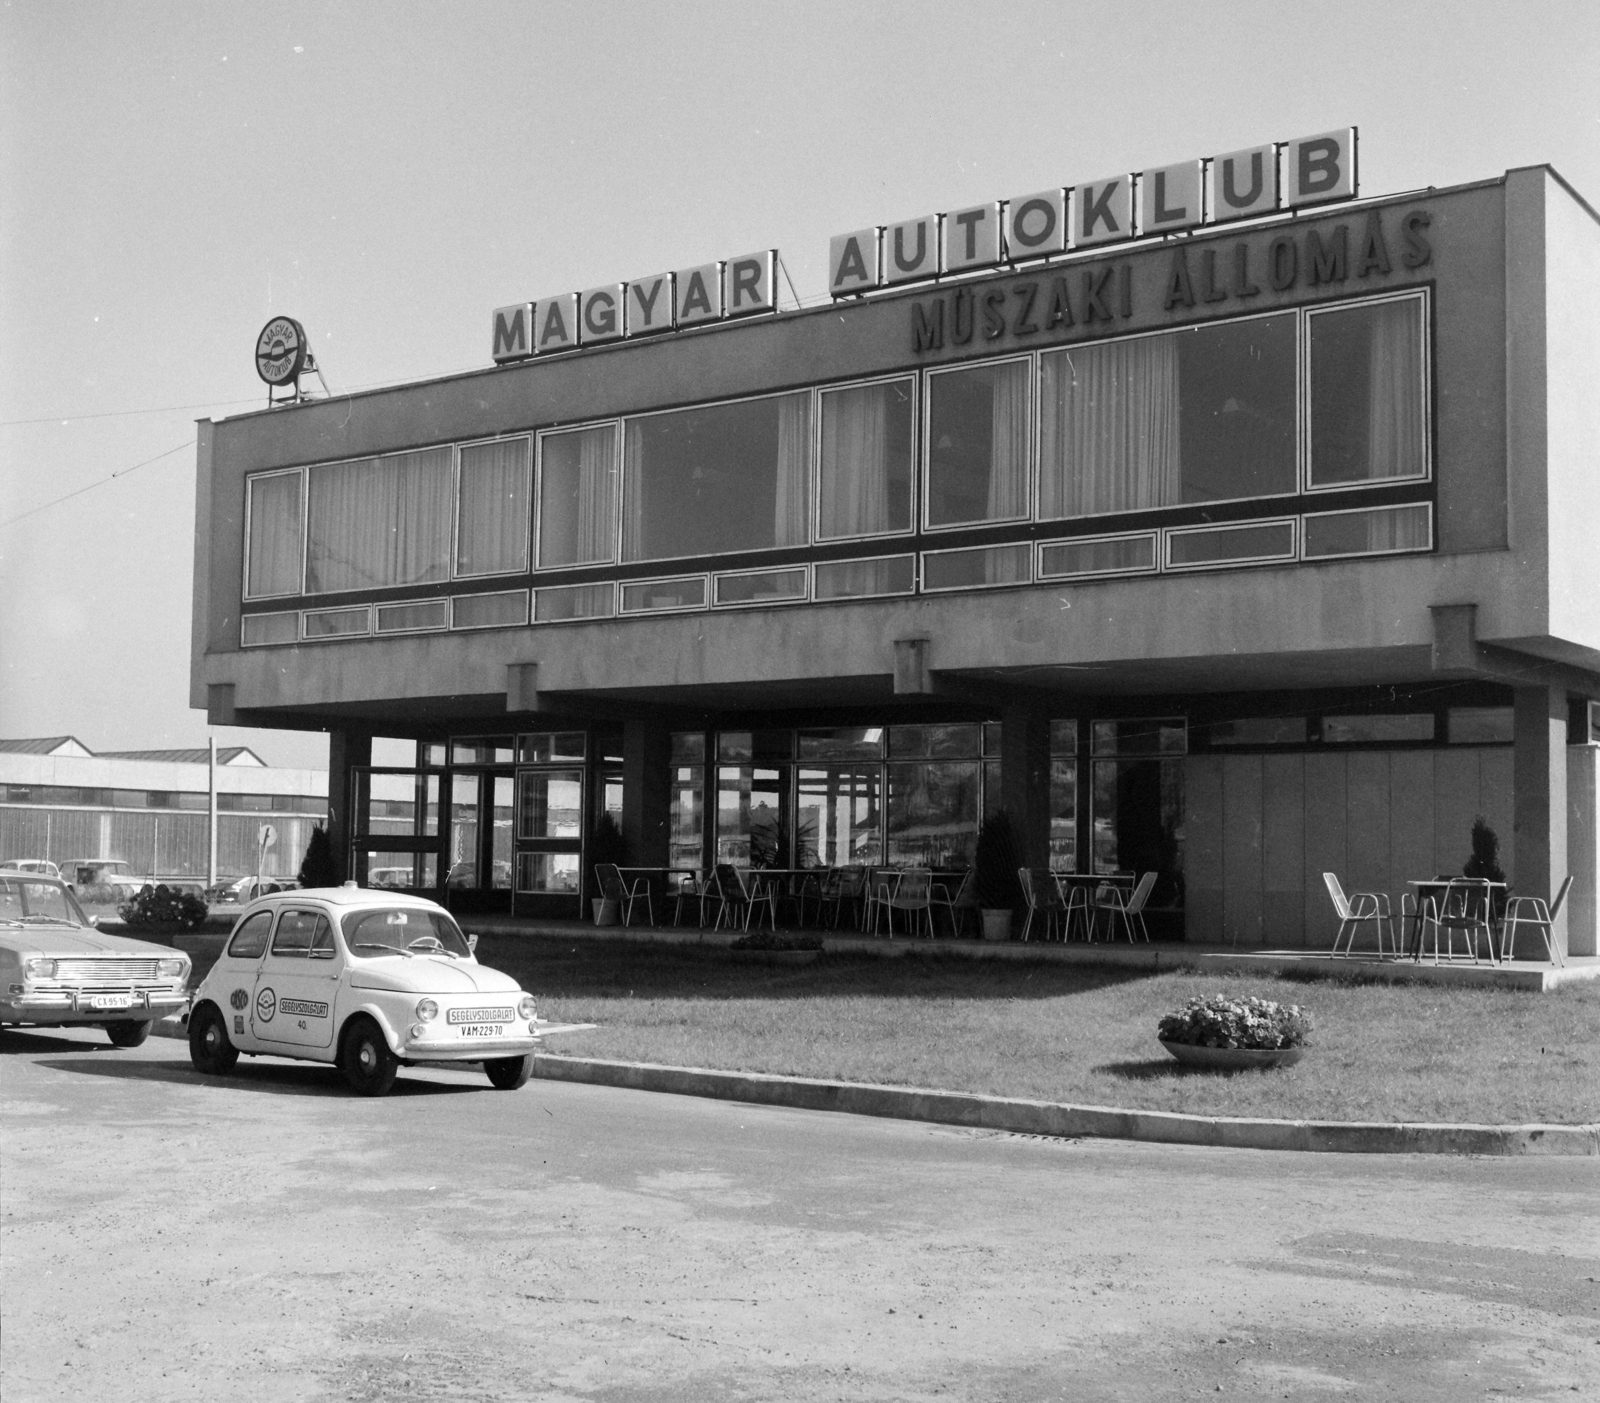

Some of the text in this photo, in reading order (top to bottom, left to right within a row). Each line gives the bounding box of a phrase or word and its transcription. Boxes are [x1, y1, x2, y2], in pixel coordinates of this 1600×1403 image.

[493, 137, 1341, 355] MAGYAR AUTOKLUB
[263, 324, 293, 346] MAGYAR
